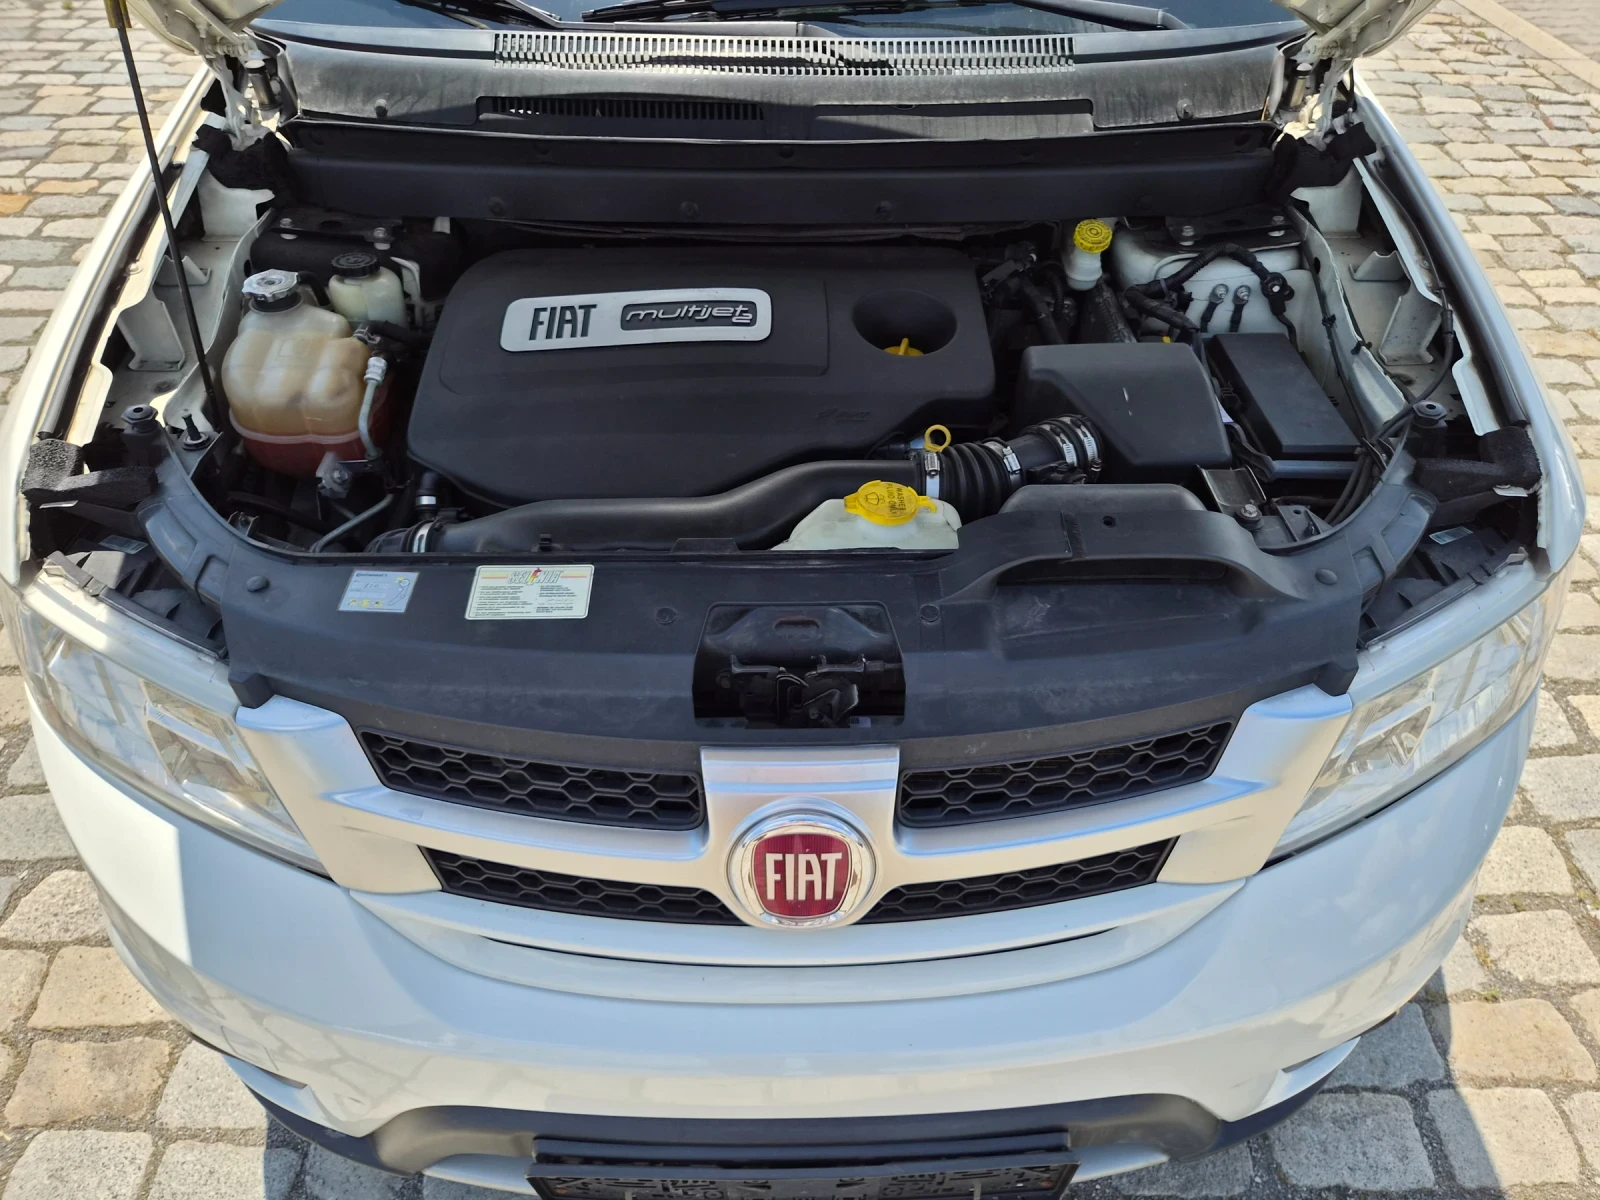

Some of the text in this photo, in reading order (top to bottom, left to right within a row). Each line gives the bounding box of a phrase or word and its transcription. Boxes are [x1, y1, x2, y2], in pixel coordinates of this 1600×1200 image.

[528, 304, 597, 340] FIAT
[625, 304, 749, 321] multijet
[886, 483, 897, 514] FLUID ONLY
[896, 487, 907, 511] WASHER
[765, 852, 842, 900] FIAT
